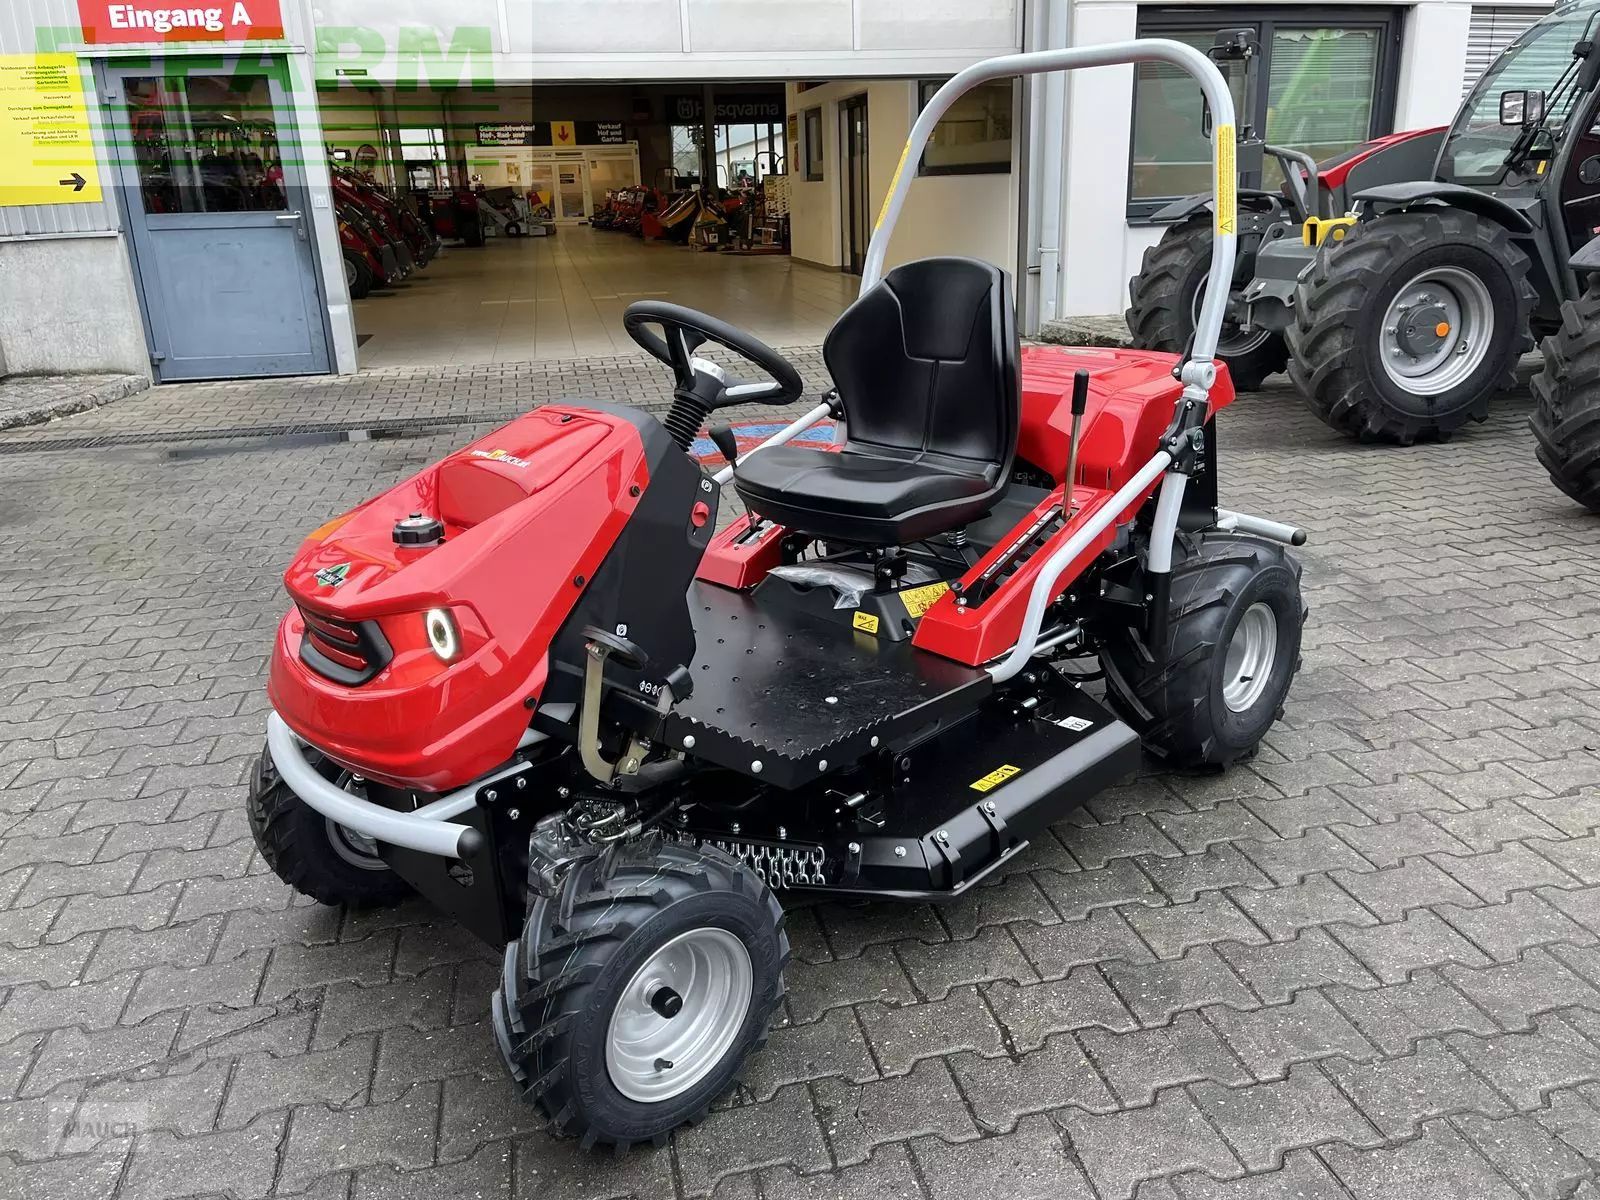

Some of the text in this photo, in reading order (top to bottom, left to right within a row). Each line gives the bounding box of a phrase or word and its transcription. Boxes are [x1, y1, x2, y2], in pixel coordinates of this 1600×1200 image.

[109, 3, 252, 32] Eingang A
[695, 102, 780, 119] Hsqvarna
